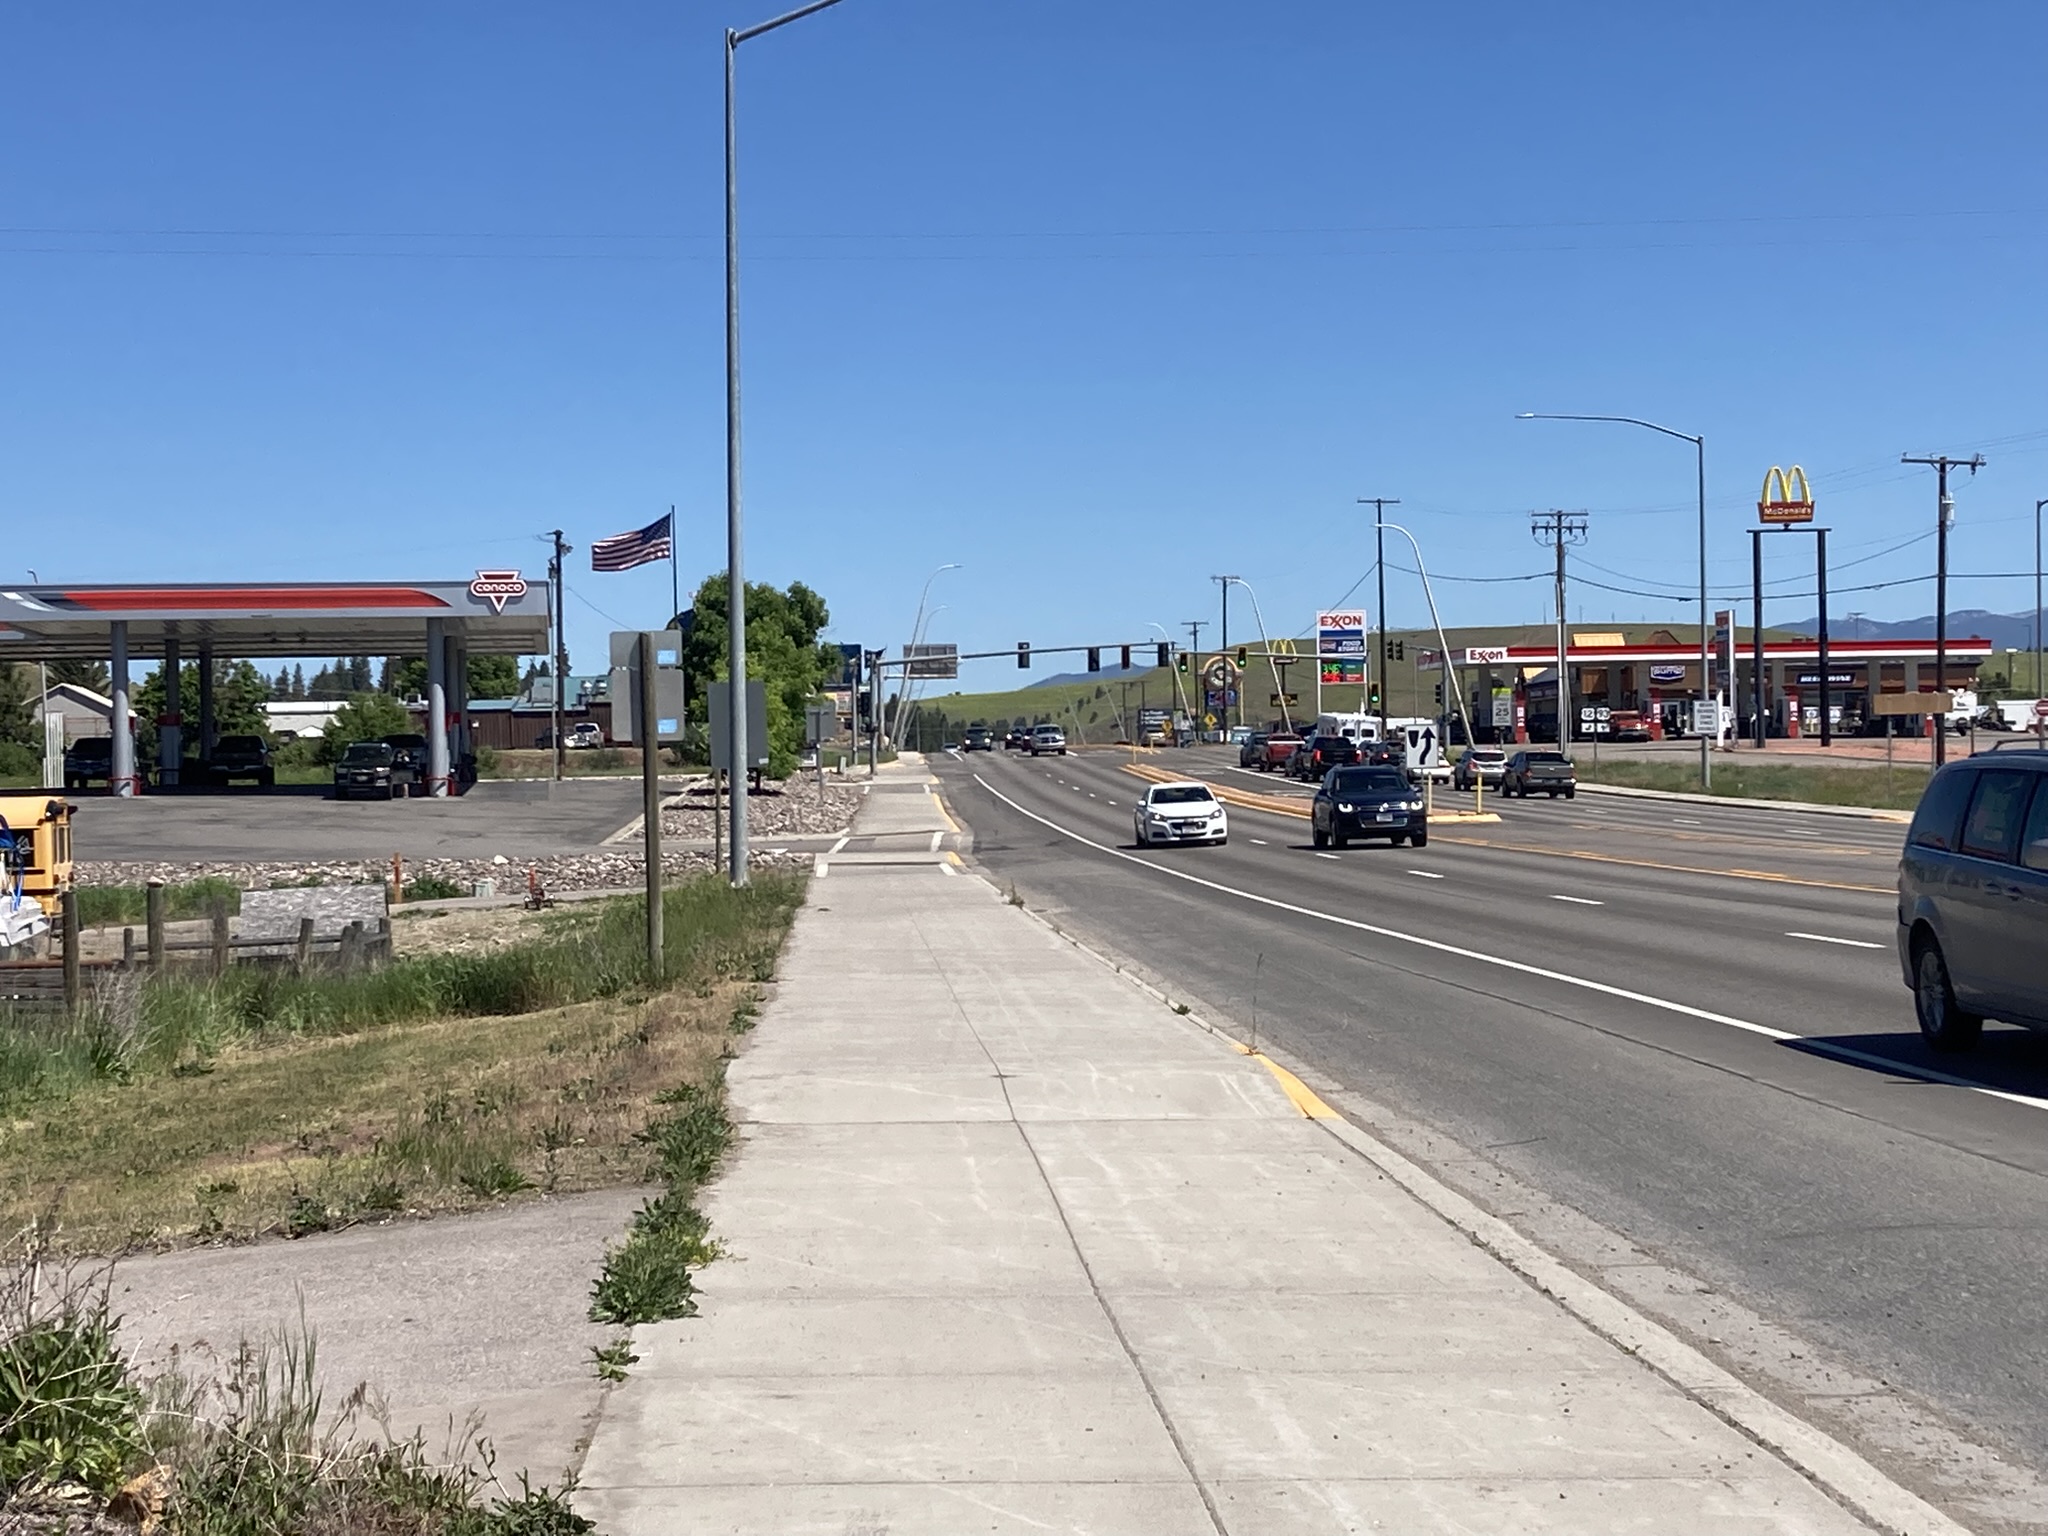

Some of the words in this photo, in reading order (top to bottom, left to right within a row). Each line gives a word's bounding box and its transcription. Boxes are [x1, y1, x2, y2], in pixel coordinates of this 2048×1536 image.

[1320, 614, 1362, 630] EXXON
[1470, 650, 1503, 663] Exxon
[1495, 708, 1509, 717] 25
[1583, 709, 1593, 718] 12
